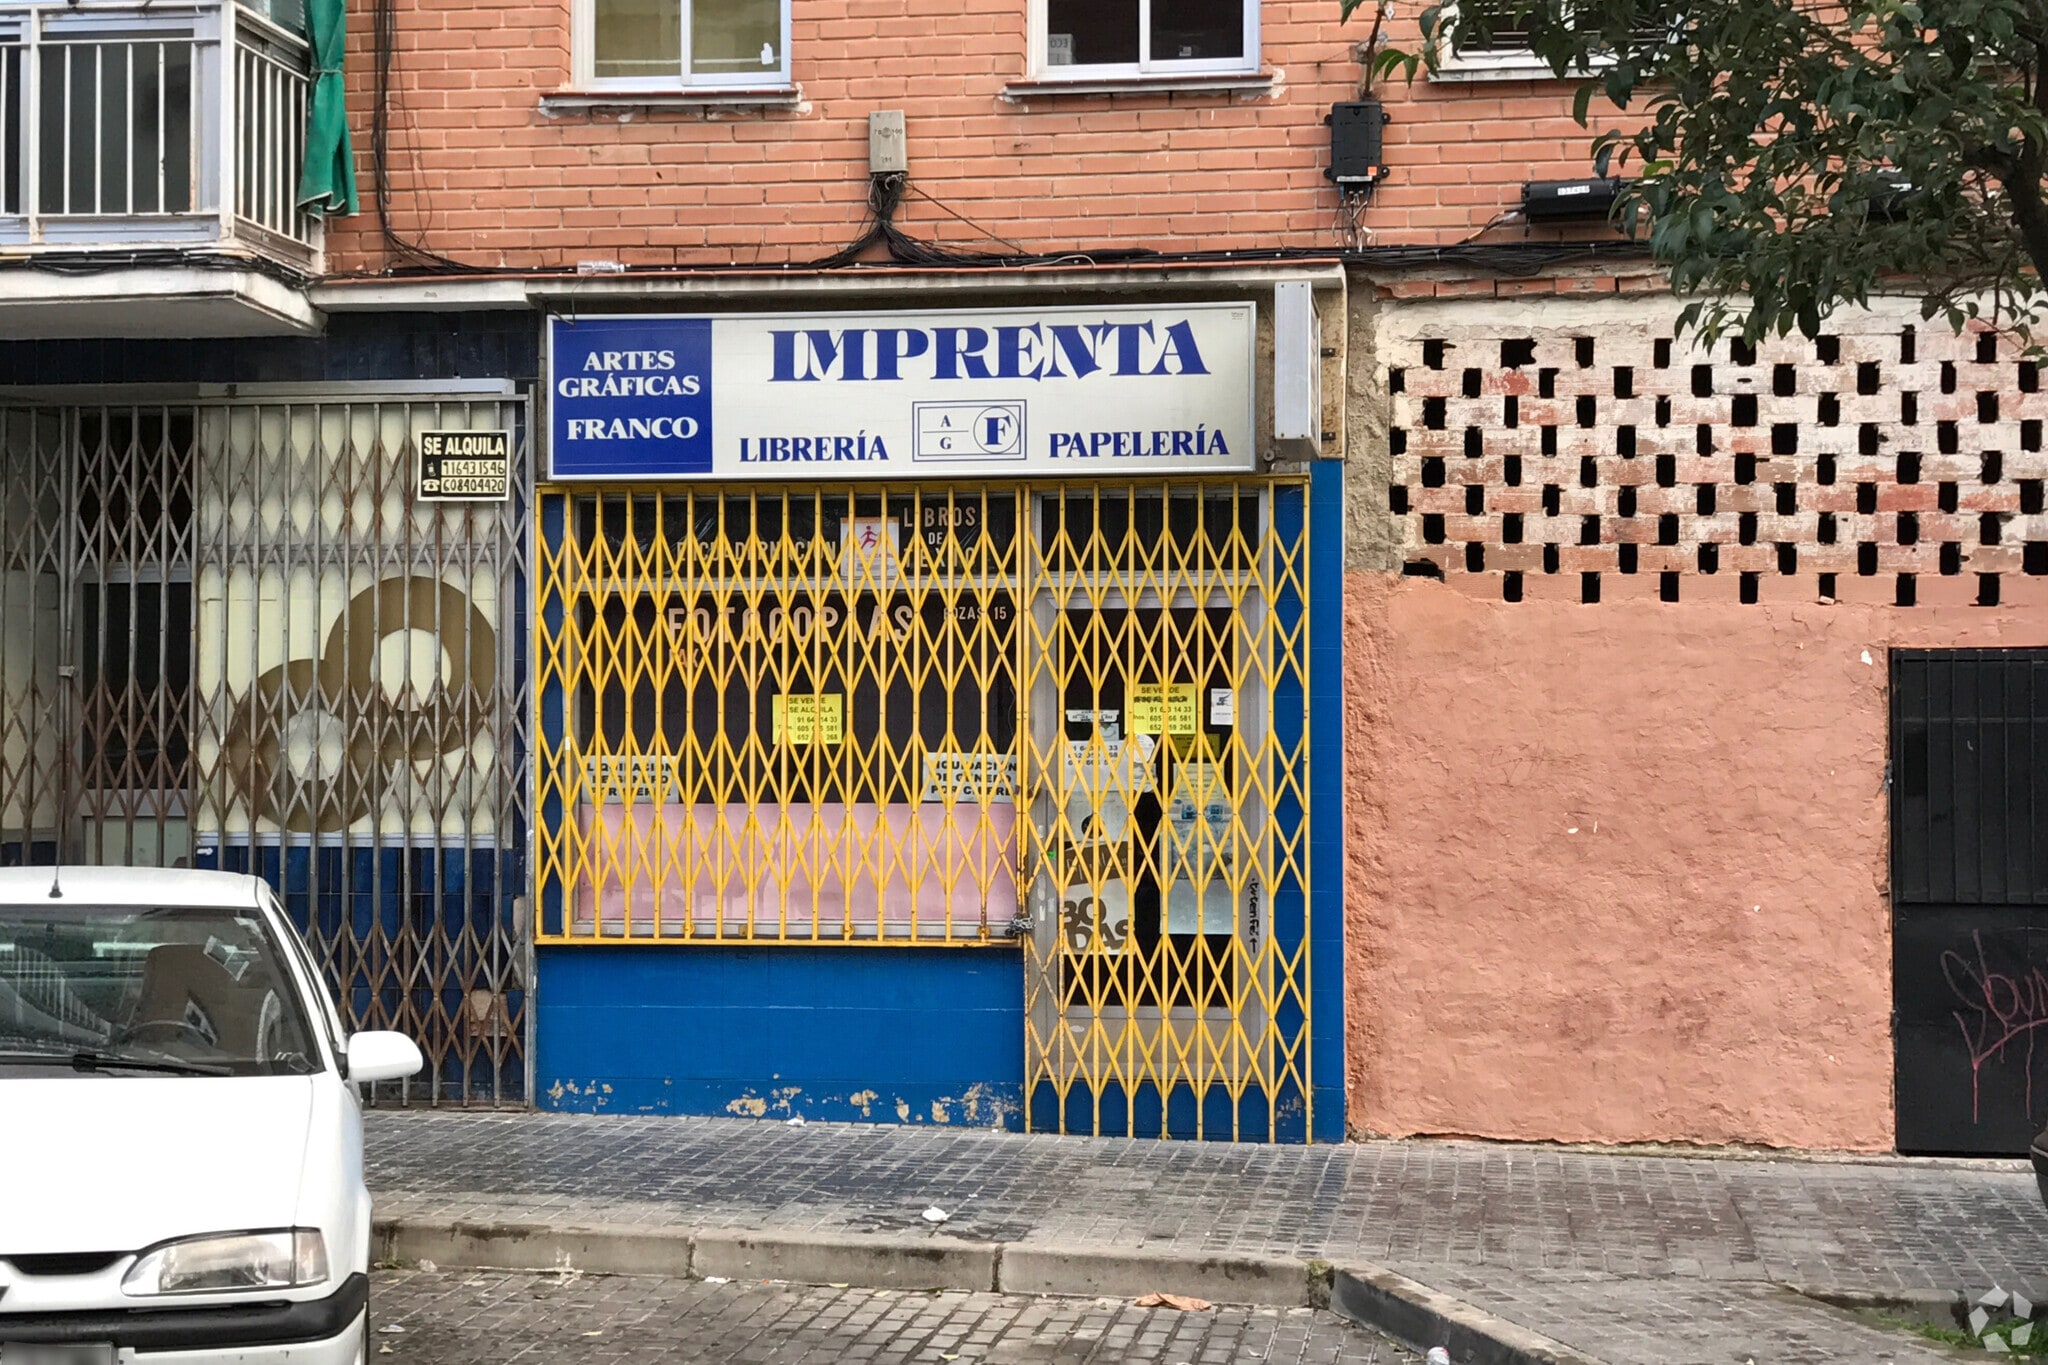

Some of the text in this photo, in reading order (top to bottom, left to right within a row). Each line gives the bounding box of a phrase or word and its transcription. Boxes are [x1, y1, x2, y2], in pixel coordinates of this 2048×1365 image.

[583, 350, 676, 372] ARTES
[766, 319, 1212, 382] IMPRENTA
[558, 372, 701, 398] GRÁFICAS
[567, 416, 699, 440] FRANCO
[940, 414, 952, 427] A
[984, 415, 1012, 445] F
[424, 436, 505, 457] SE ALQUILA
[739, 429, 890, 462] LIBRERÍA
[940, 436, 952, 450] G
[1049, 423, 1230, 458] PAPELERÍA
[443, 461, 505, 475] 916431546
[903, 506, 976, 528] LBROS
[928, 531, 943, 546] DE
[994, 606, 1007, 620] 15
[1141, 686, 1180, 694] SE VEDE
[788, 697, 826, 705] SE VENE
[788, 706, 799, 714] SE
